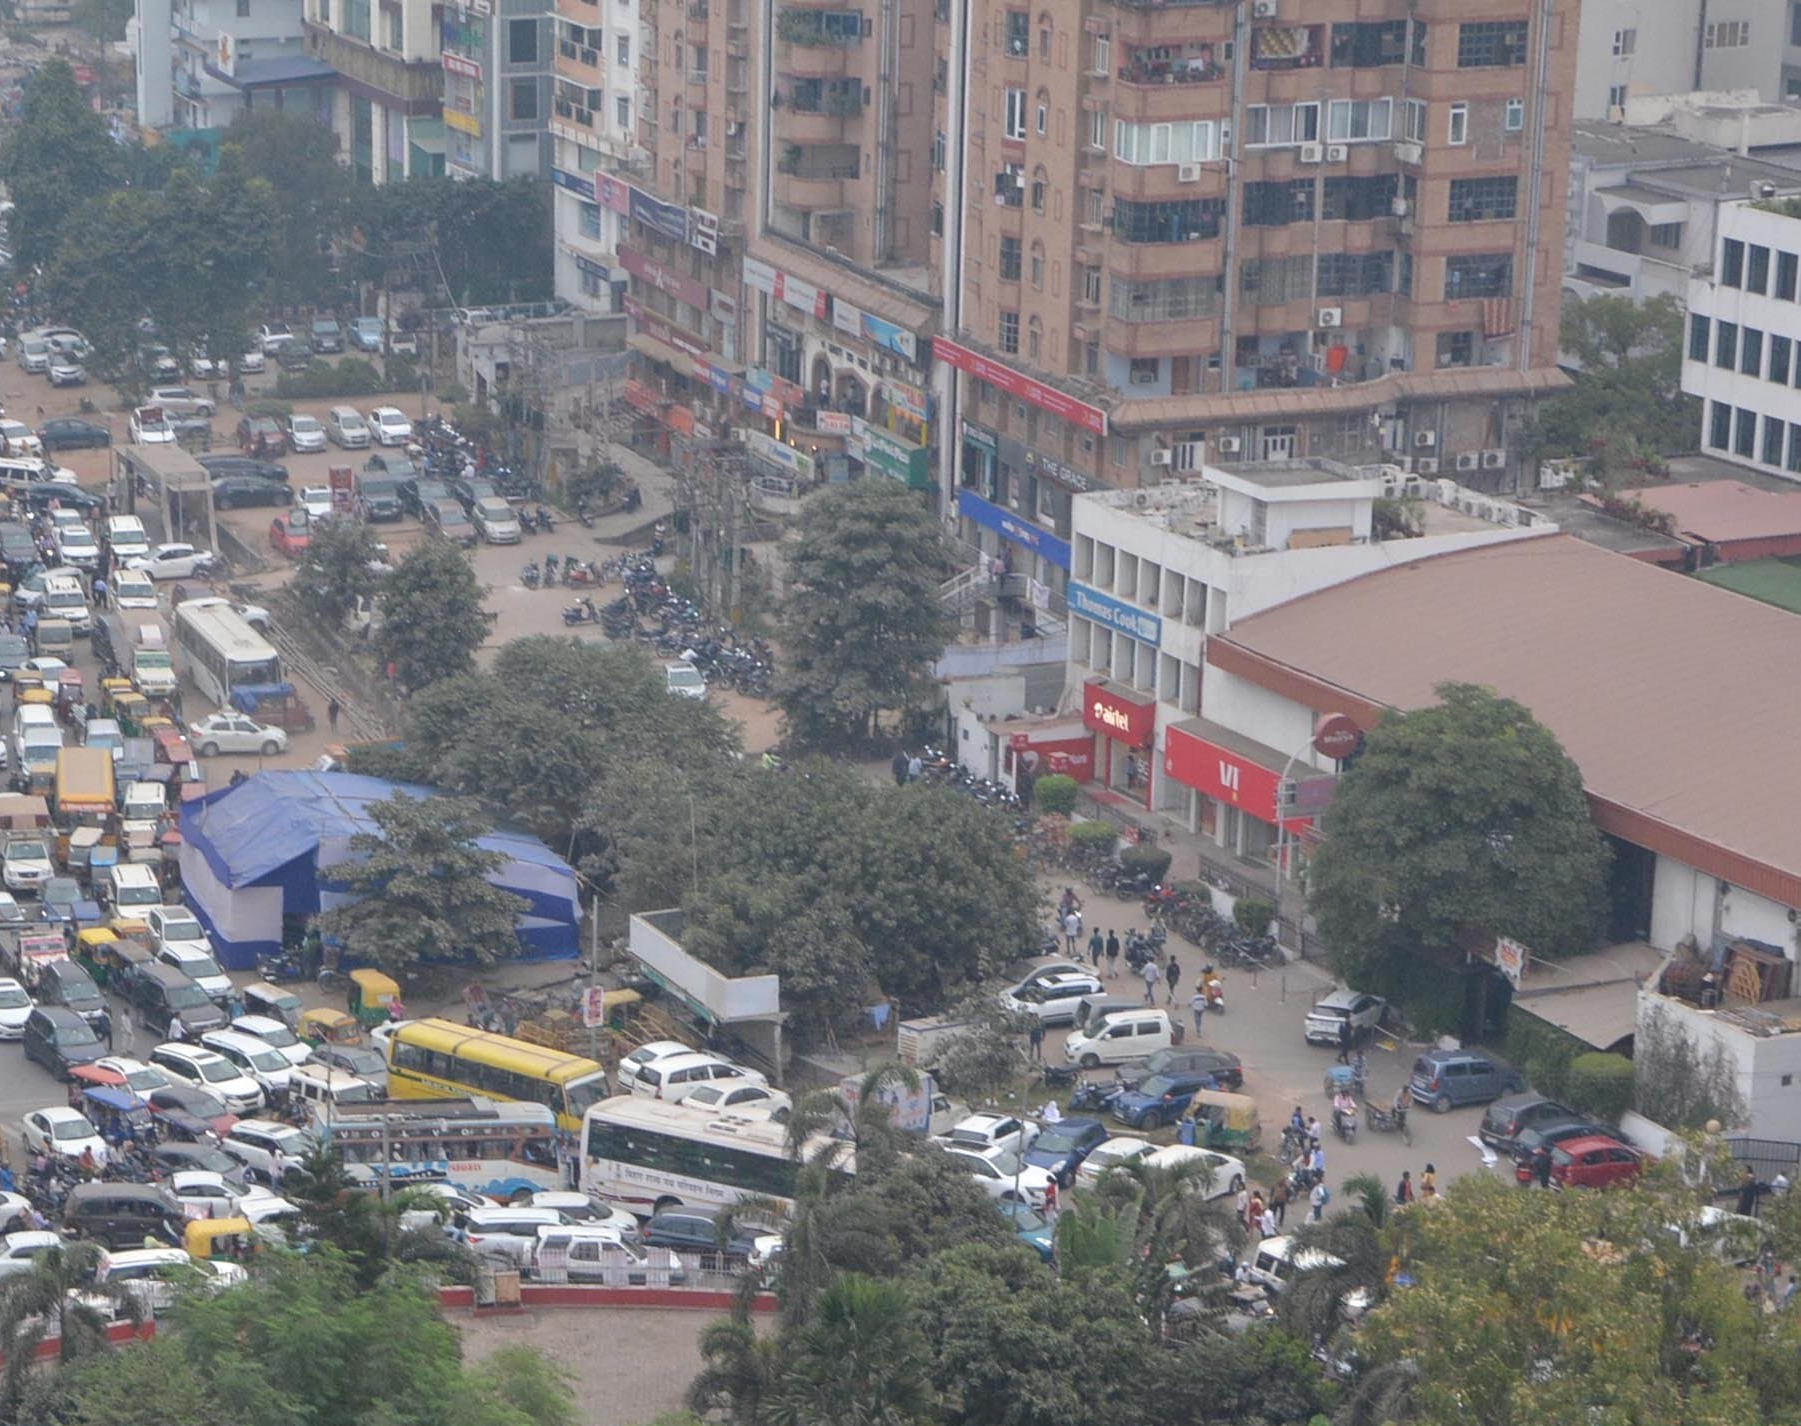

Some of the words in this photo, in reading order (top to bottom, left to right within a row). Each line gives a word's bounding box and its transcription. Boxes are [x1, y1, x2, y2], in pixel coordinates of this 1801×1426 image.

[1042, 457, 1058, 477] THE
[1059, 466, 1088, 491] GRACE
[1077, 591, 1112, 620] Thomas
[1114, 607, 1137, 633] Cook
[1103, 706, 1129, 732] airtel
